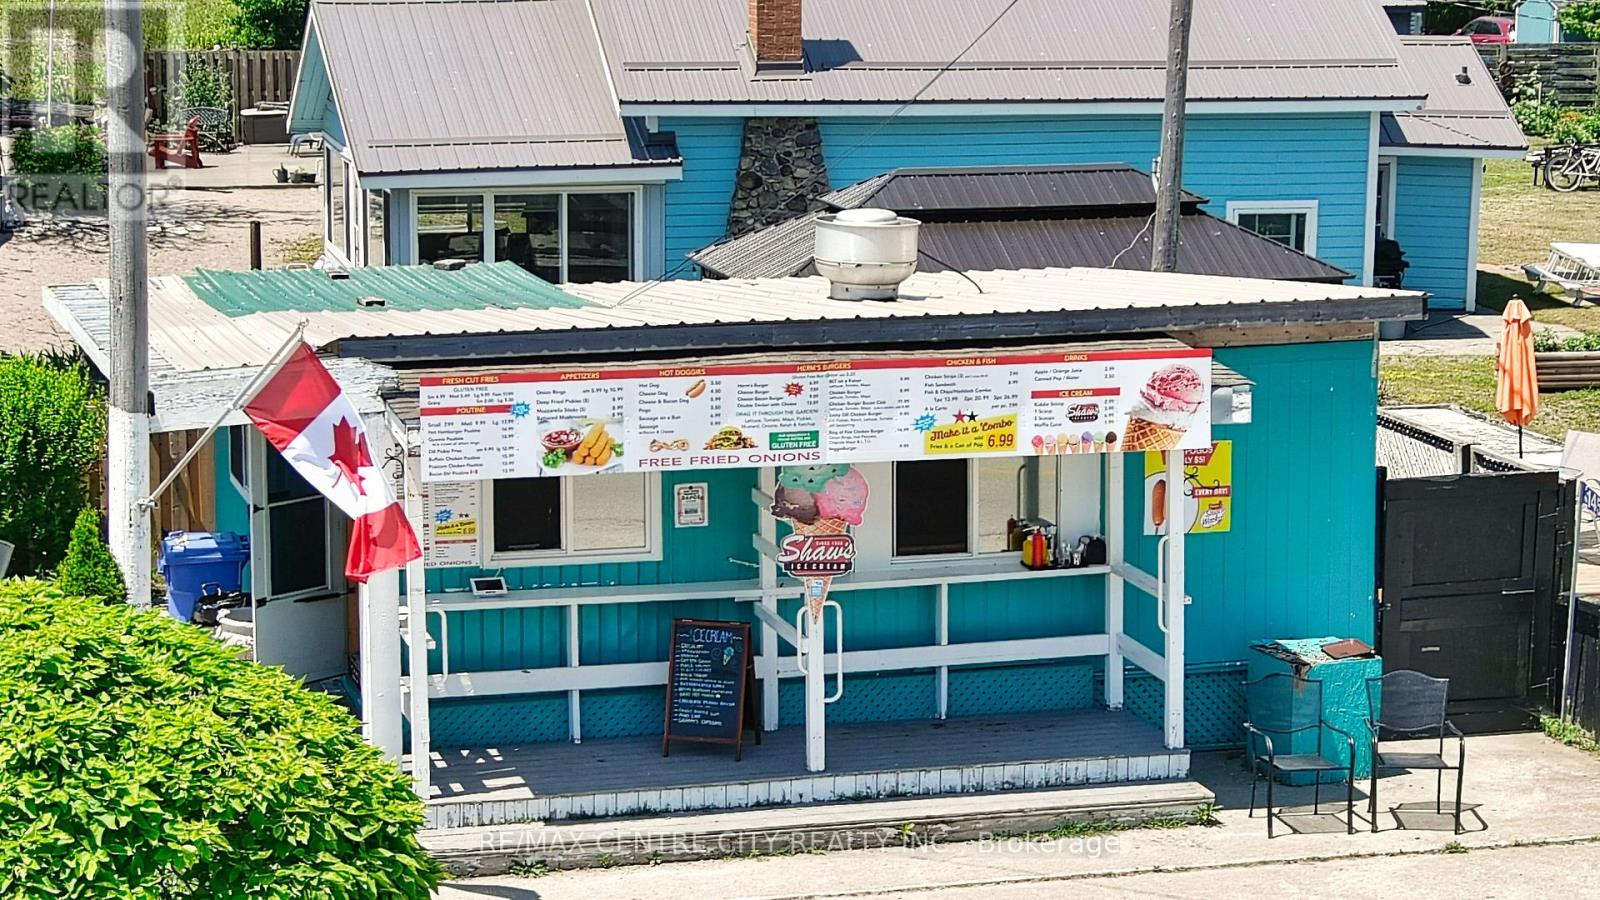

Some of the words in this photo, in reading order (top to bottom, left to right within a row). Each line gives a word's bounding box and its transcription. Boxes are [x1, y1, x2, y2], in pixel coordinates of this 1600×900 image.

[822, 362, 851, 371] BURGERS
[560, 372, 600, 380] APPETIZERS
[675, 368, 706, 376] DOGGIES
[1070, 389, 1094, 397] CREAM
[930, 429, 961, 441] Make
[961, 426, 970, 435] it
[980, 419, 1014, 431] Combo
[772, 441, 798, 449] GLUTEN
[799, 440, 817, 448] FREE
[988, 433, 1014, 448] 6.99
[639, 457, 682, 468] FREE
[689, 455, 740, 466] FRIED
[748, 451, 821, 464] ONIONS
[1184, 456, 1192, 464] LY
[1194, 487, 1213, 496] EVERY
[777, 534, 854, 562] Shaw's
[811, 562, 847, 570] CREAM
